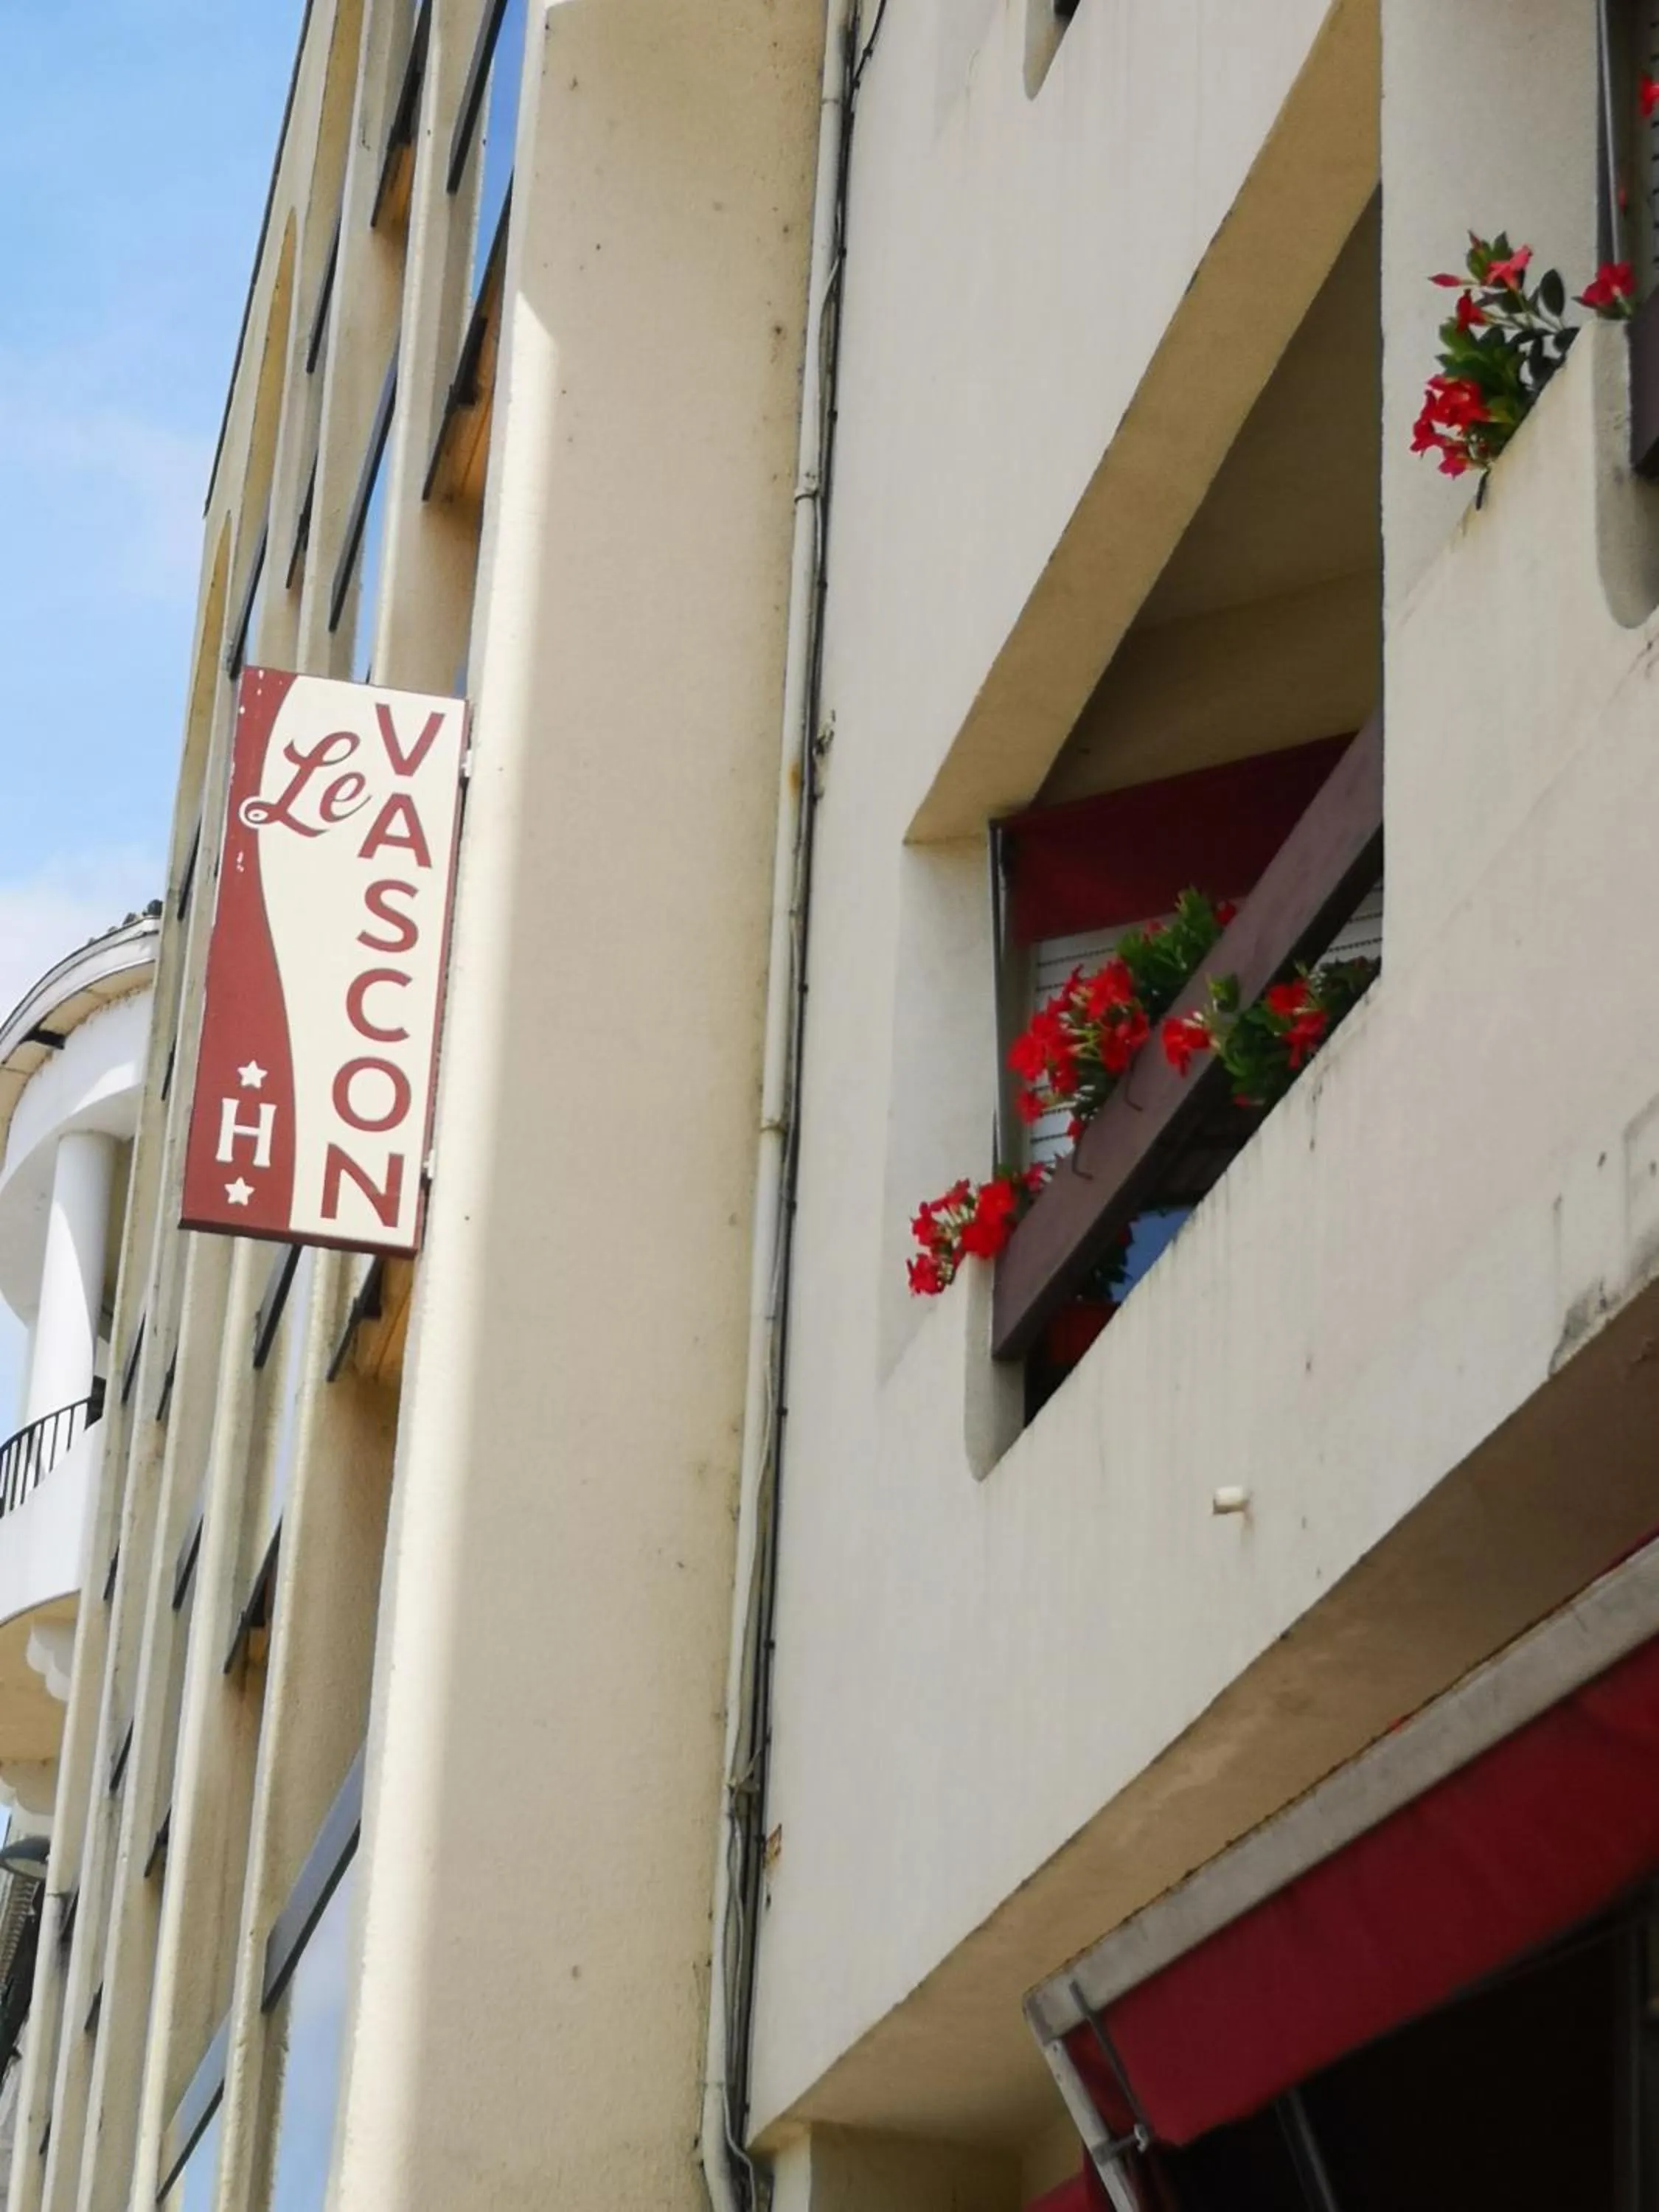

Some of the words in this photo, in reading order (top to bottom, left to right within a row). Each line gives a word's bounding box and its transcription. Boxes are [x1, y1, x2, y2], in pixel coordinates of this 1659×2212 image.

[243, 731, 372, 838] Le
[320, 702, 446, 1228] VASCON
[215, 1097, 277, 1167] H
